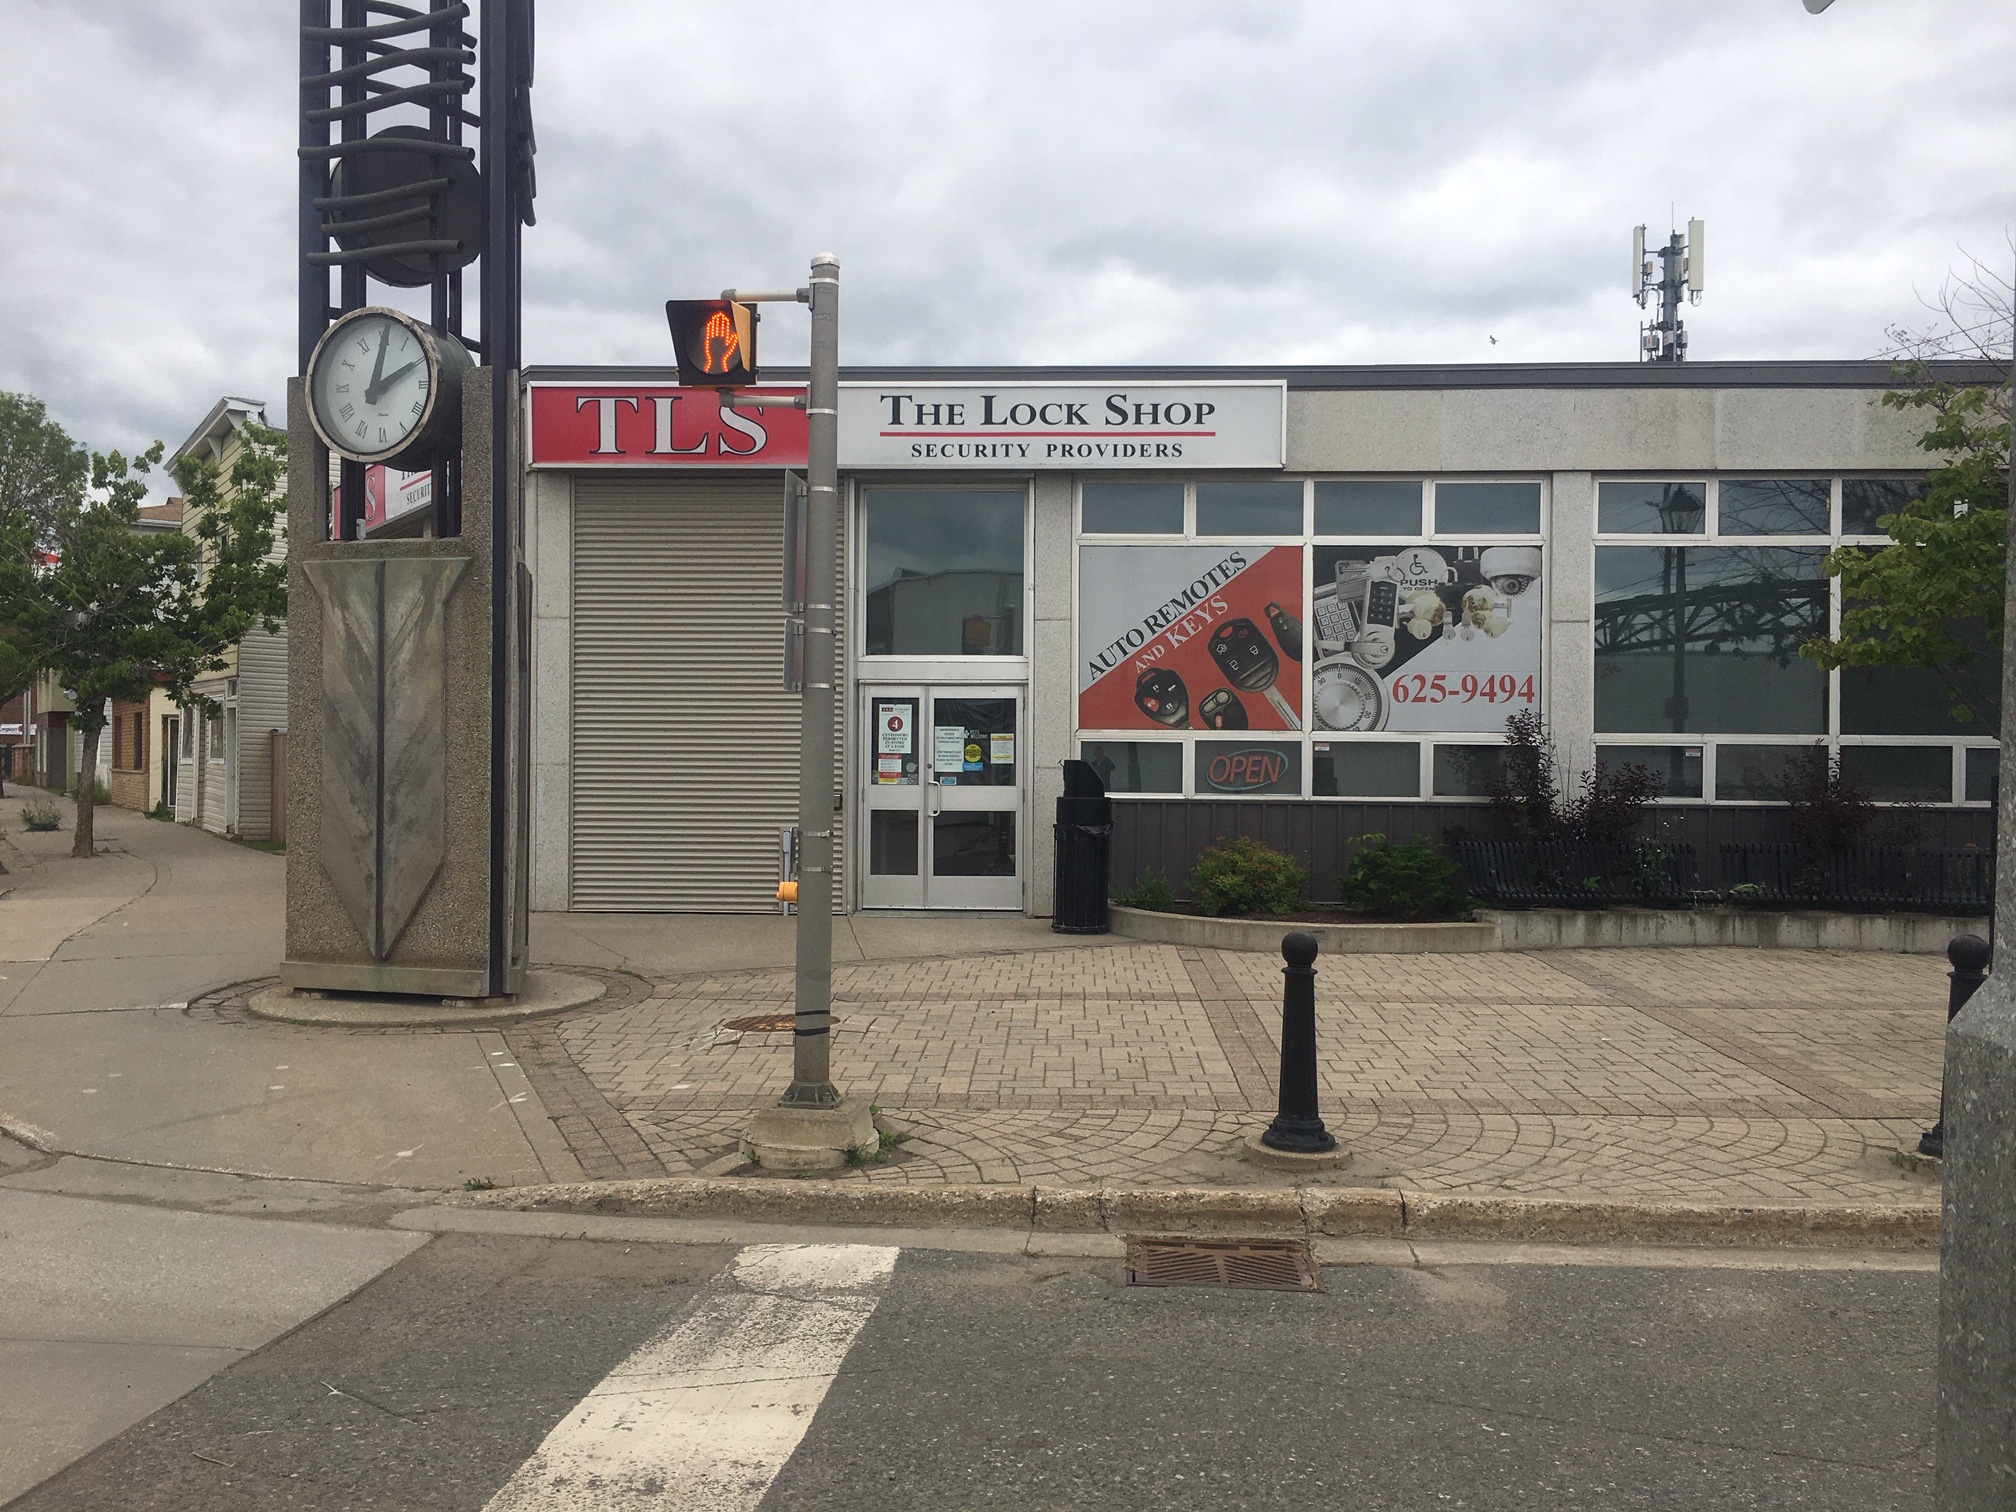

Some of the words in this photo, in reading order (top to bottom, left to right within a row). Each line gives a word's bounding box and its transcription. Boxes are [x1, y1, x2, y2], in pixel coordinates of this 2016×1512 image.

[880, 394, 965, 426] THE
[980, 394, 1090, 426] LOCK
[1105, 393, 1216, 426] SHOP
[576, 395, 769, 456] TLS
[911, 443, 1031, 458] SECURITY
[1046, 443, 1184, 458] PROVIDERS
[1400, 579, 1438, 587] PUSH
[1088, 628, 1145, 681] AUTO
[1141, 550, 1247, 637] REMOTES
[1134, 645, 1165, 674] AND
[1163, 594, 1229, 649] KEYS
[1392, 673, 1536, 704] 625-9494
[892, 719, 899, 729] 4
[1208, 755, 1282, 783] OPEN
